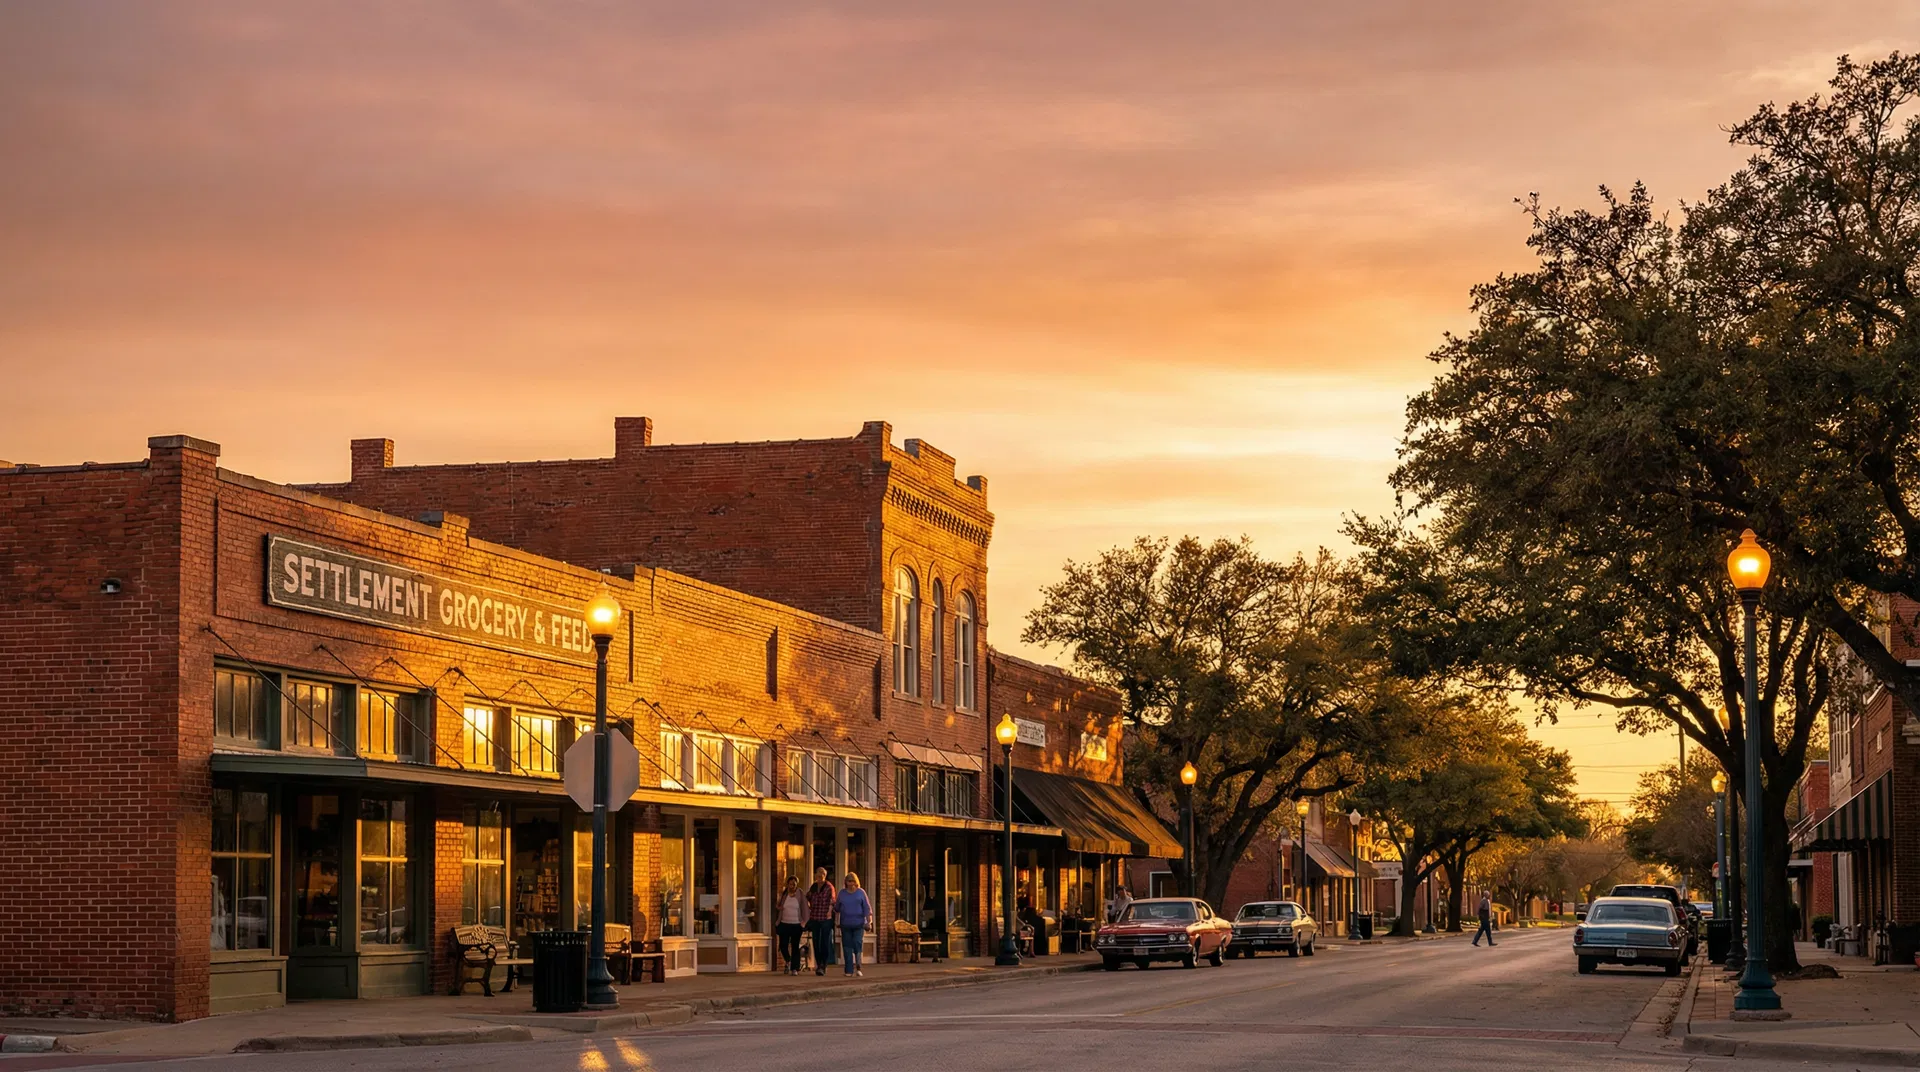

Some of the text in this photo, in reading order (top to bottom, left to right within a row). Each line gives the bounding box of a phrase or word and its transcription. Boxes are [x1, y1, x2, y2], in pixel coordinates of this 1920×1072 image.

[283, 553, 593, 654] SETTLEMENT GROCERY & FEED
